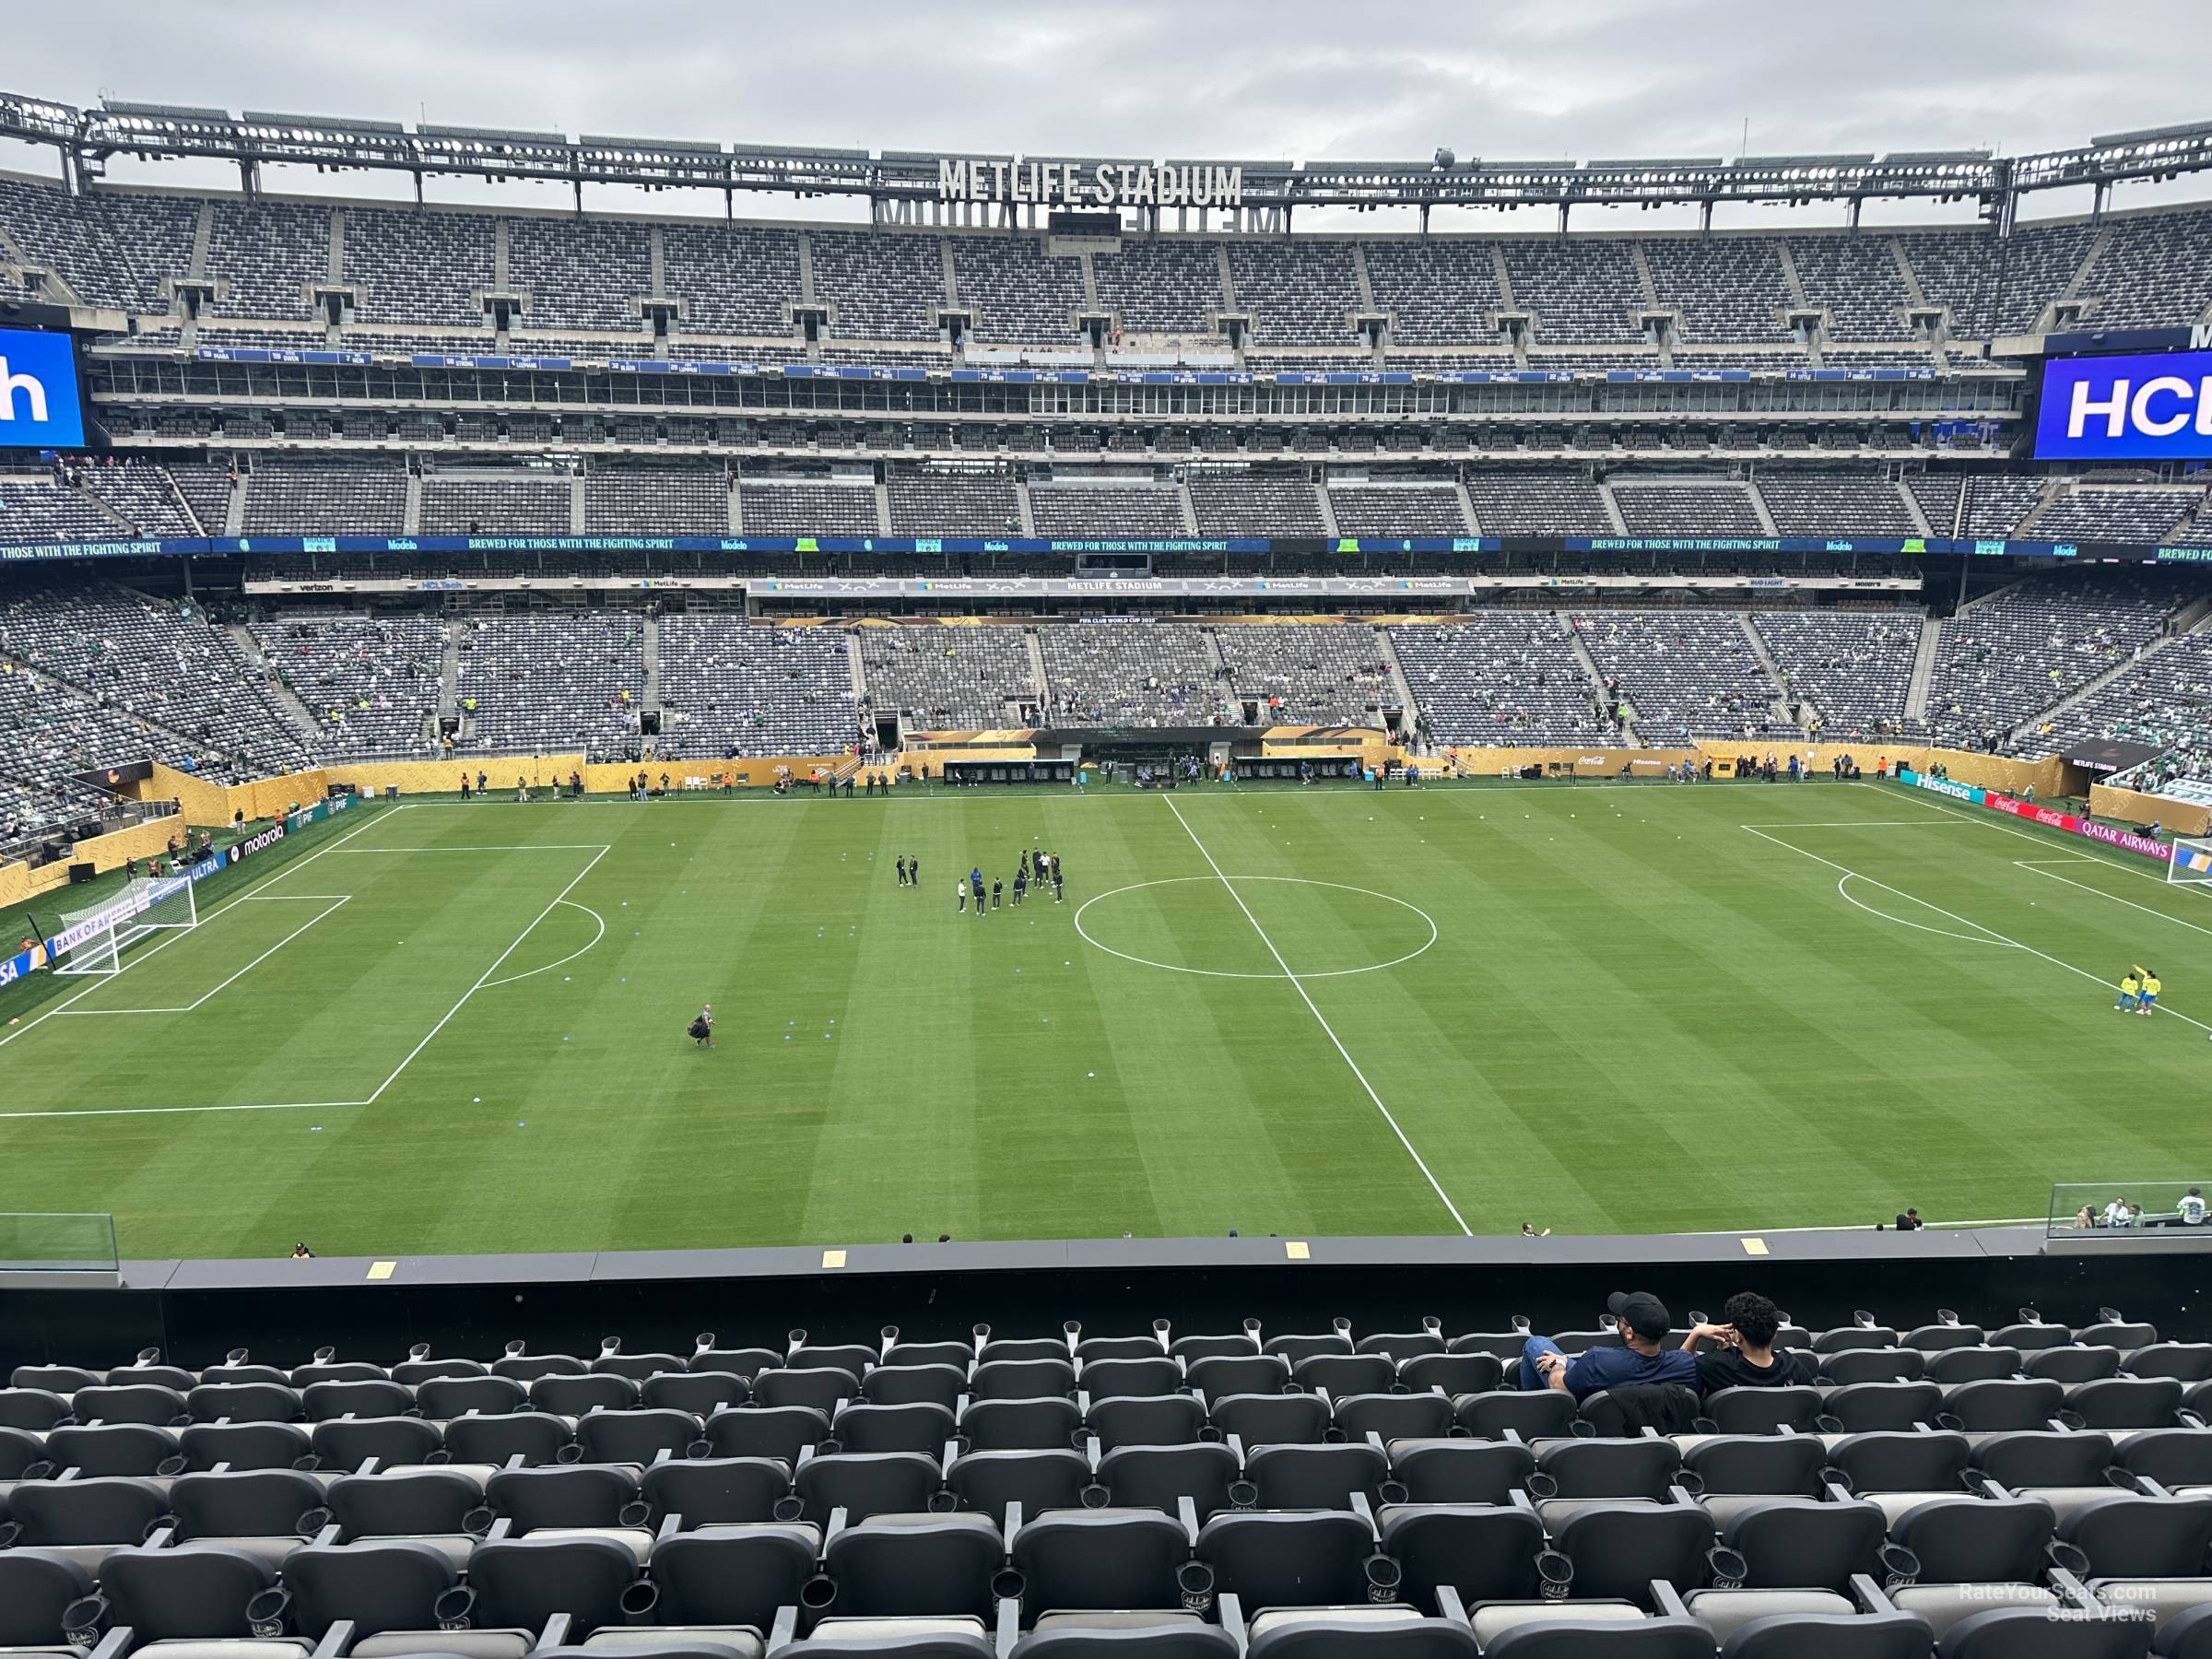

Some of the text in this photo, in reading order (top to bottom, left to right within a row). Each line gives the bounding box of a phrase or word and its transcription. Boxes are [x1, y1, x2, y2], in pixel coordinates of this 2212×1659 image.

[939, 159, 1242, 206] METLIFE STADIUM
[388, 539, 417, 549] Modelo
[469, 538, 674, 548] BREWED FOR THOSE WITH THE FIGHTING SPIRIT
[721, 539, 747, 549] Modelo
[984, 540, 1008, 550] Modelo
[1052, 541, 1227, 550] BREWED FOR THOSE WITH THE FIGHTING SPIRIT
[1592, 540, 1780, 549] BREWED FOR THOSE WITH THE FIGHTING SPIRIT
[1827, 540, 1853, 550] Modelo
[2, 542, 161, 559] THOSE WITH THE FIGHTING SPIRIT
[2158, 547, 2199, 560] BREWED
[300, 582, 333, 592] verizon
[422, 581, 463, 590] HCLTech
[2073, 759, 2094, 769] METLIFE
[1917, 773, 1971, 800] Hisense
[335, 798, 347, 811] PIF
[303, 811, 313, 824] PIF
[244, 824, 284, 855] motorola
[2082, 821, 2168, 857] QATAR AIRWAYS
[193, 858, 218, 880] ULTRA
[56, 929, 83, 950] BANK
[84, 922, 98, 935] OF
